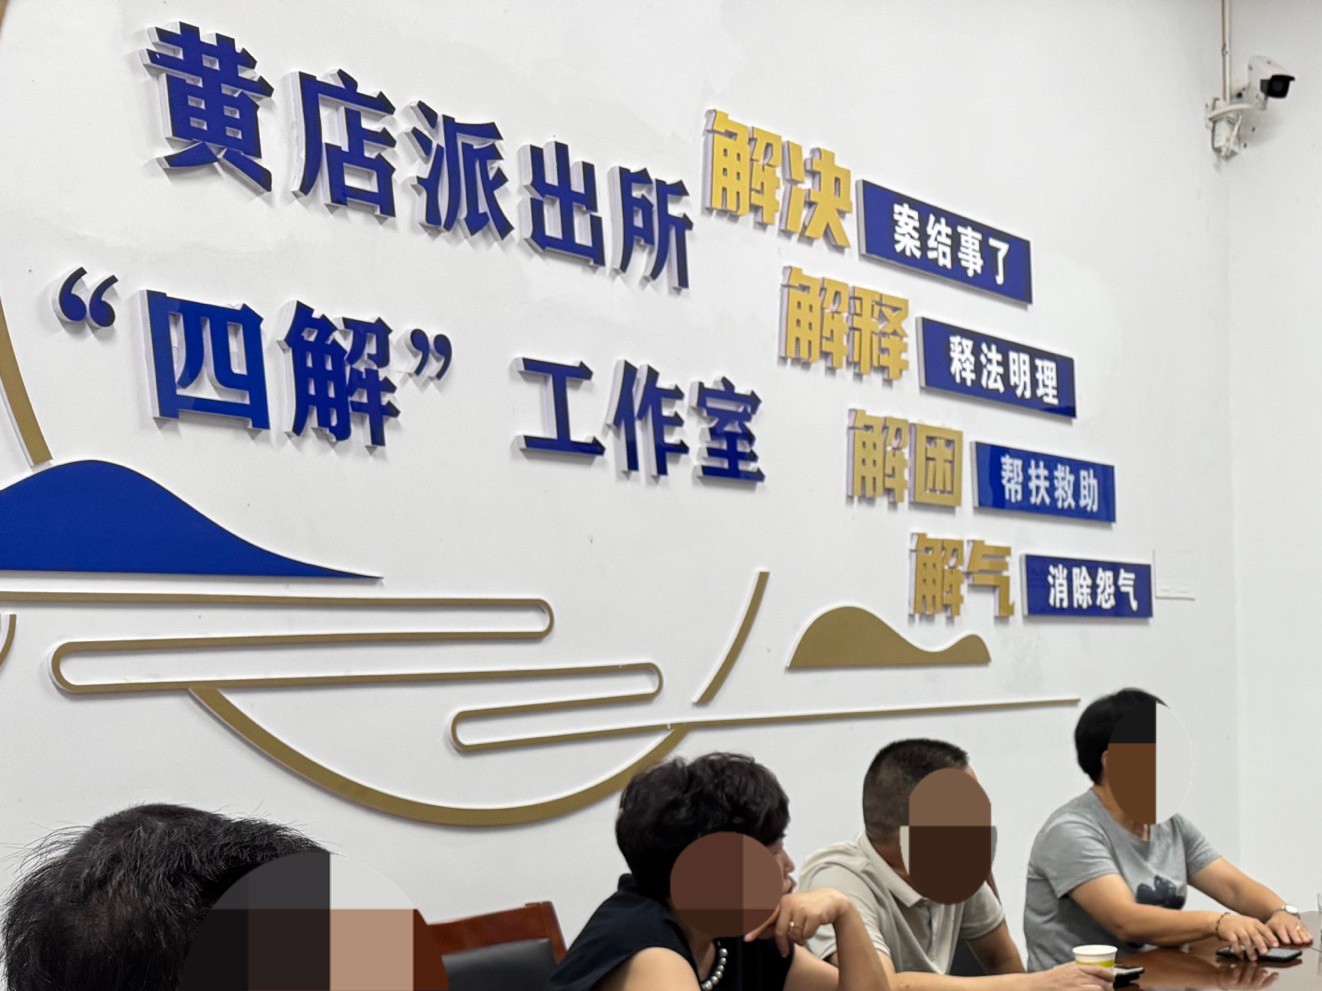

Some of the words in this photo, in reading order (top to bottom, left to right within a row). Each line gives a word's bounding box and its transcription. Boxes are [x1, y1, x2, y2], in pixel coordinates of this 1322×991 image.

[141, 21, 694, 290] 黄店派出所
[706, 109, 851, 248] 解决
[893, 203, 1011, 285] 案结事了
[779, 265, 909, 380] 解释
[948, 335, 1060, 406] 释法明理
[846, 408, 963, 507] 解困
[1000, 454, 1099, 512] 帮扶救助
[909, 532, 1014, 618] 解气
[1046, 564, 1138, 612] 消除怨气
